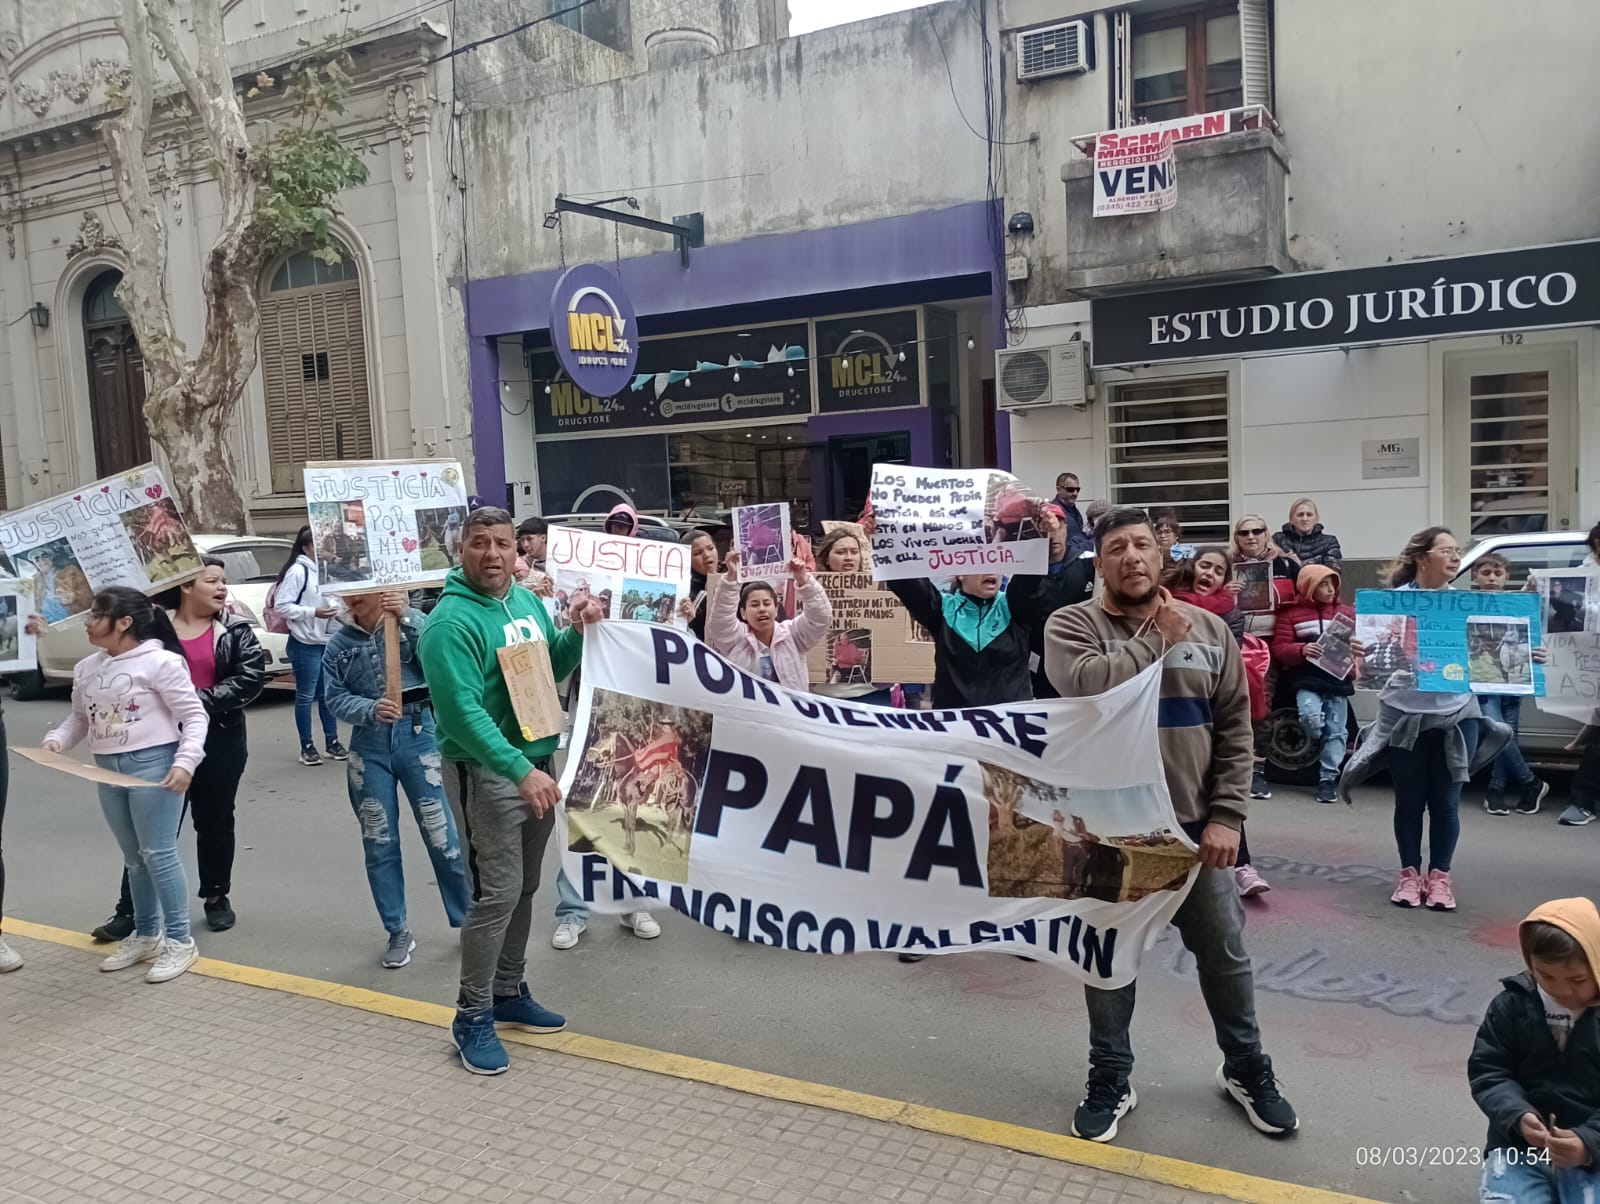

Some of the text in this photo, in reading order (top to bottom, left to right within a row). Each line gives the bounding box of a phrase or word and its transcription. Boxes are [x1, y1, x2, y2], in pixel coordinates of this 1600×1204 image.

[1148, 272, 1577, 345] ESTUDIO JURÍDICO
[568, 312, 618, 352] MCL
[1500, 334, 1523, 346] 132
[832, 353, 886, 388] MCL
[839, 385, 892, 398] DRUGSTORE
[558, 415, 611, 426] DRUGSTORE
[312, 474, 446, 502] JUSTICIA
[873, 471, 906, 487] LOS
[871, 487, 888, 501] NO
[0, 487, 141, 550] JUSTICIA
[367, 505, 411, 533] POR
[875, 520, 898, 534] STÁ
[871, 535, 985, 550] LOS VIVOS LUCHAR
[552, 529, 685, 581] JUSTICIA
[872, 553, 892, 569] POR
[1383, 591, 1501, 614] JUSTICIA
[694, 763, 985, 889] PAPÁ
